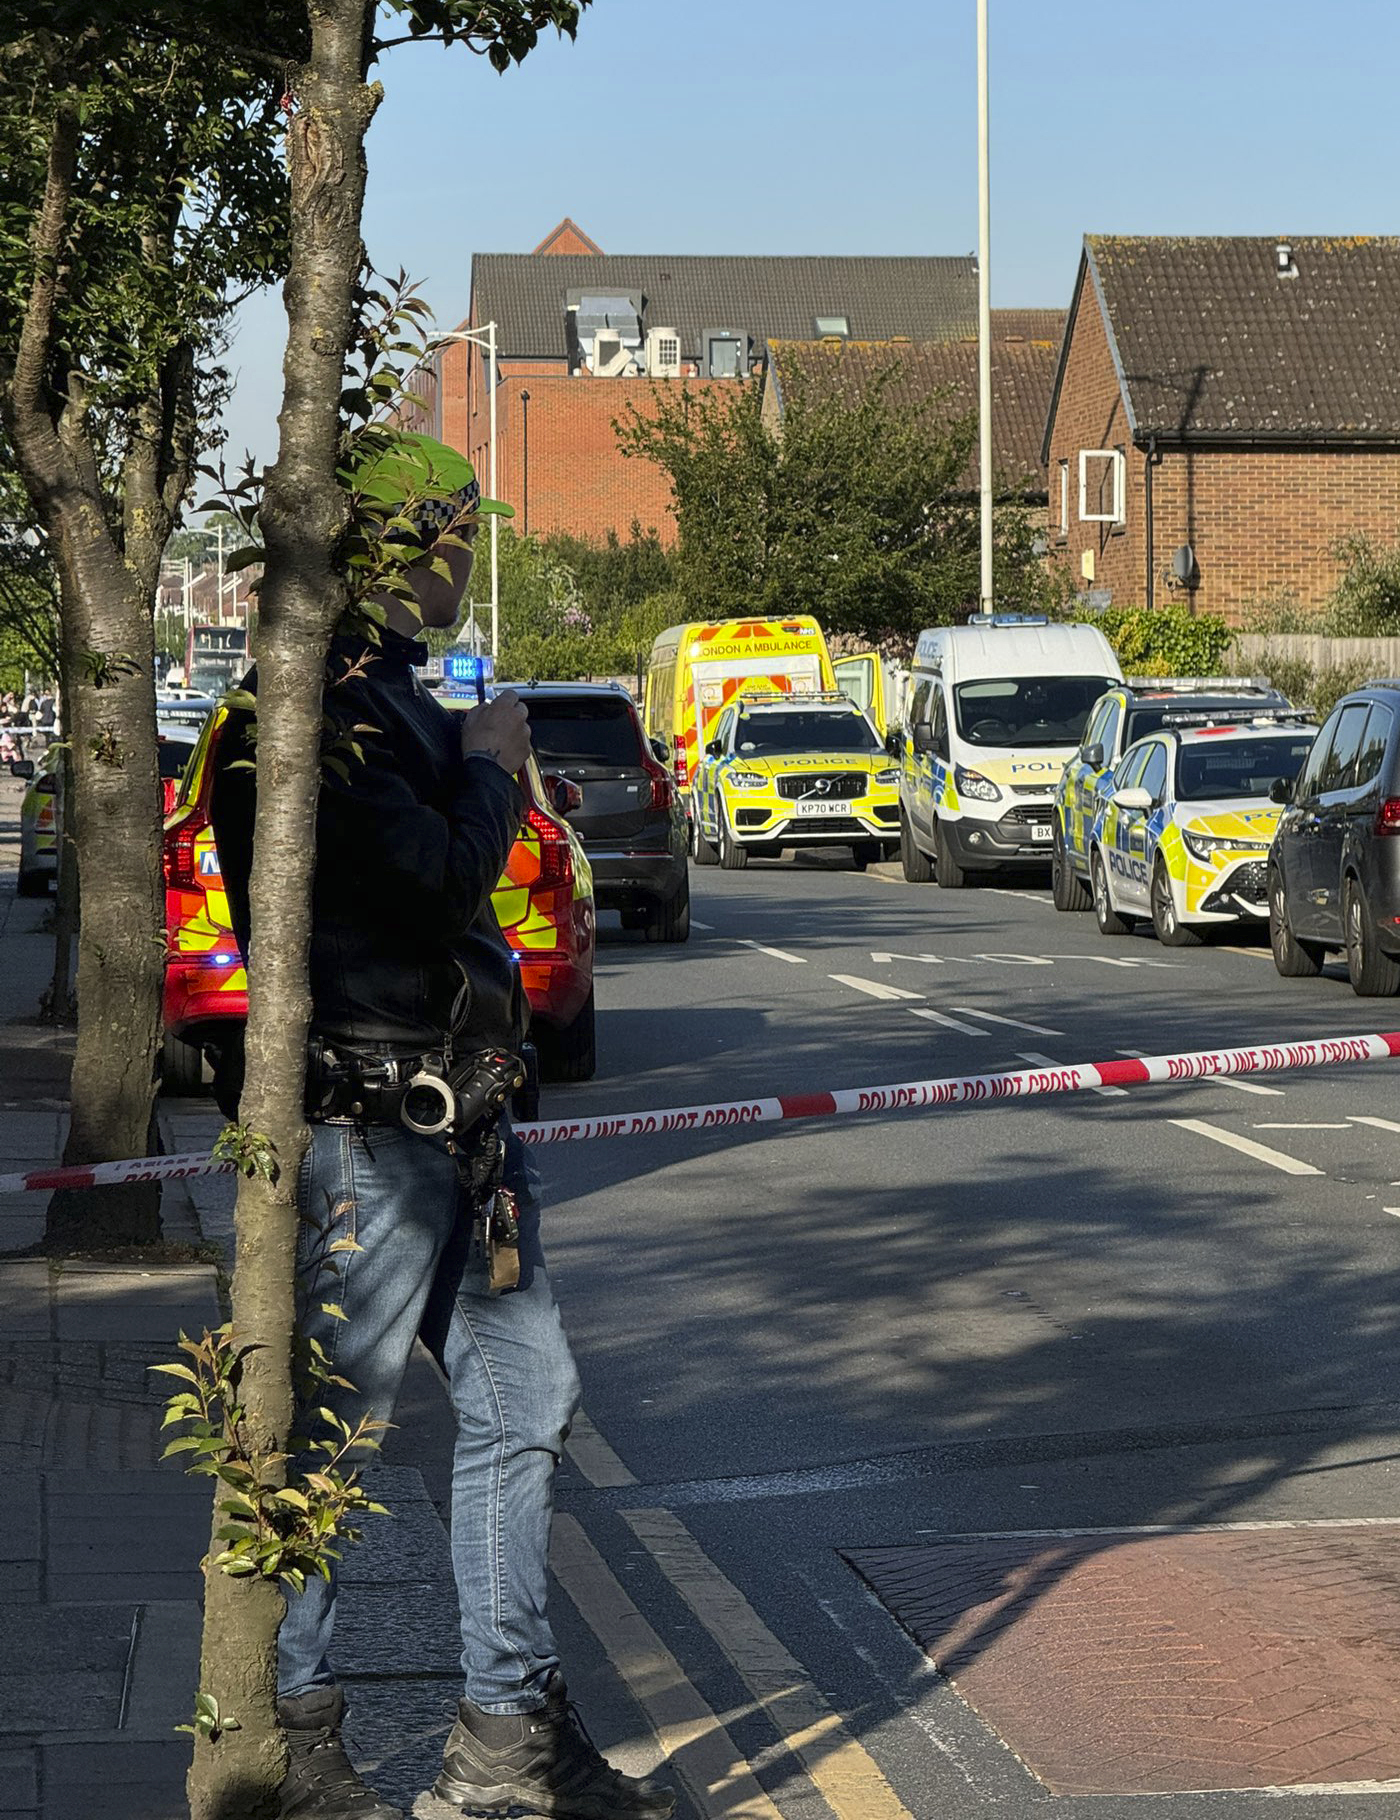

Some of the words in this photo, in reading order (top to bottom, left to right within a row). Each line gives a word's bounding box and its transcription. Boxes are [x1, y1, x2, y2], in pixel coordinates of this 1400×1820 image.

[699, 644, 741, 657] ONDON
[745, 640, 812, 653] AMBULANCE
[783, 758, 859, 767] POLICE
[801, 803, 826, 813] KP70
[828, 803, 847, 813] WCR
[1037, 828, 1054, 837] BX
[1109, 850, 1149, 886] POLICE
